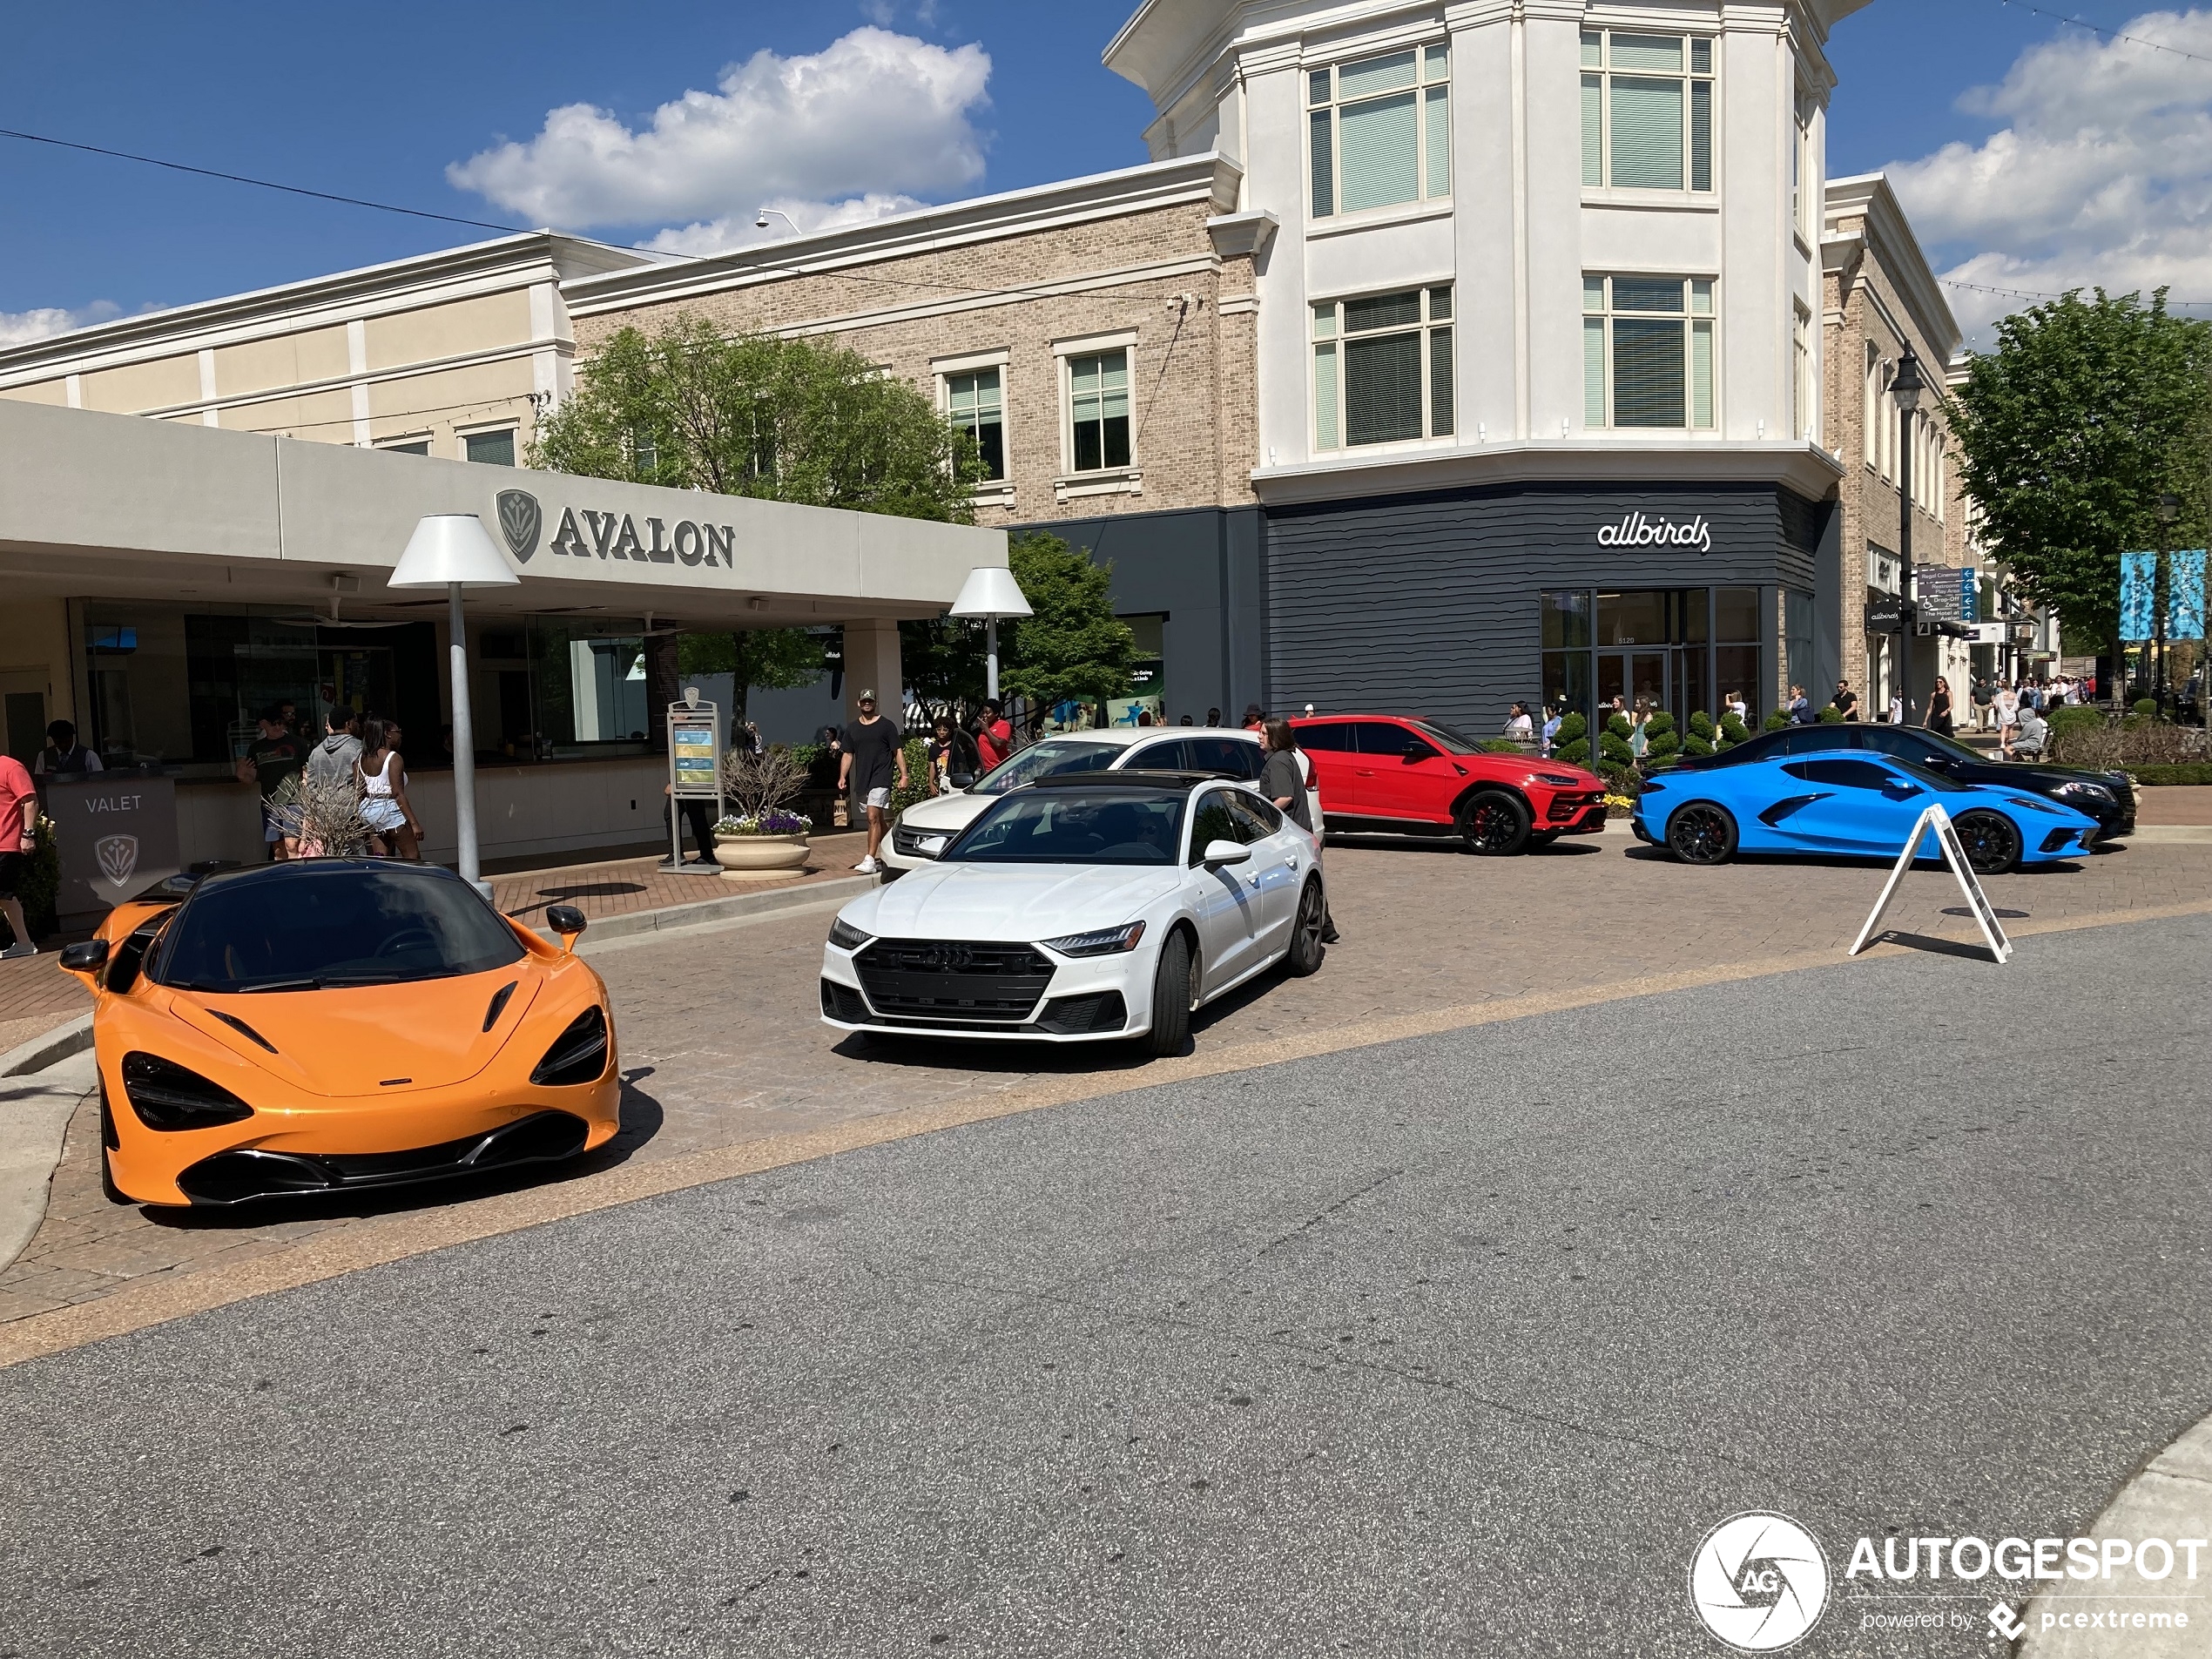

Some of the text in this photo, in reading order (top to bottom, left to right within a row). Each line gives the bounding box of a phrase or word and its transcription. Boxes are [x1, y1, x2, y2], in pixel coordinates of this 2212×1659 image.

[550, 506, 735, 569] AVALON
[1596, 511, 1711, 552] allbirds
[85, 794, 142, 813] VALET
